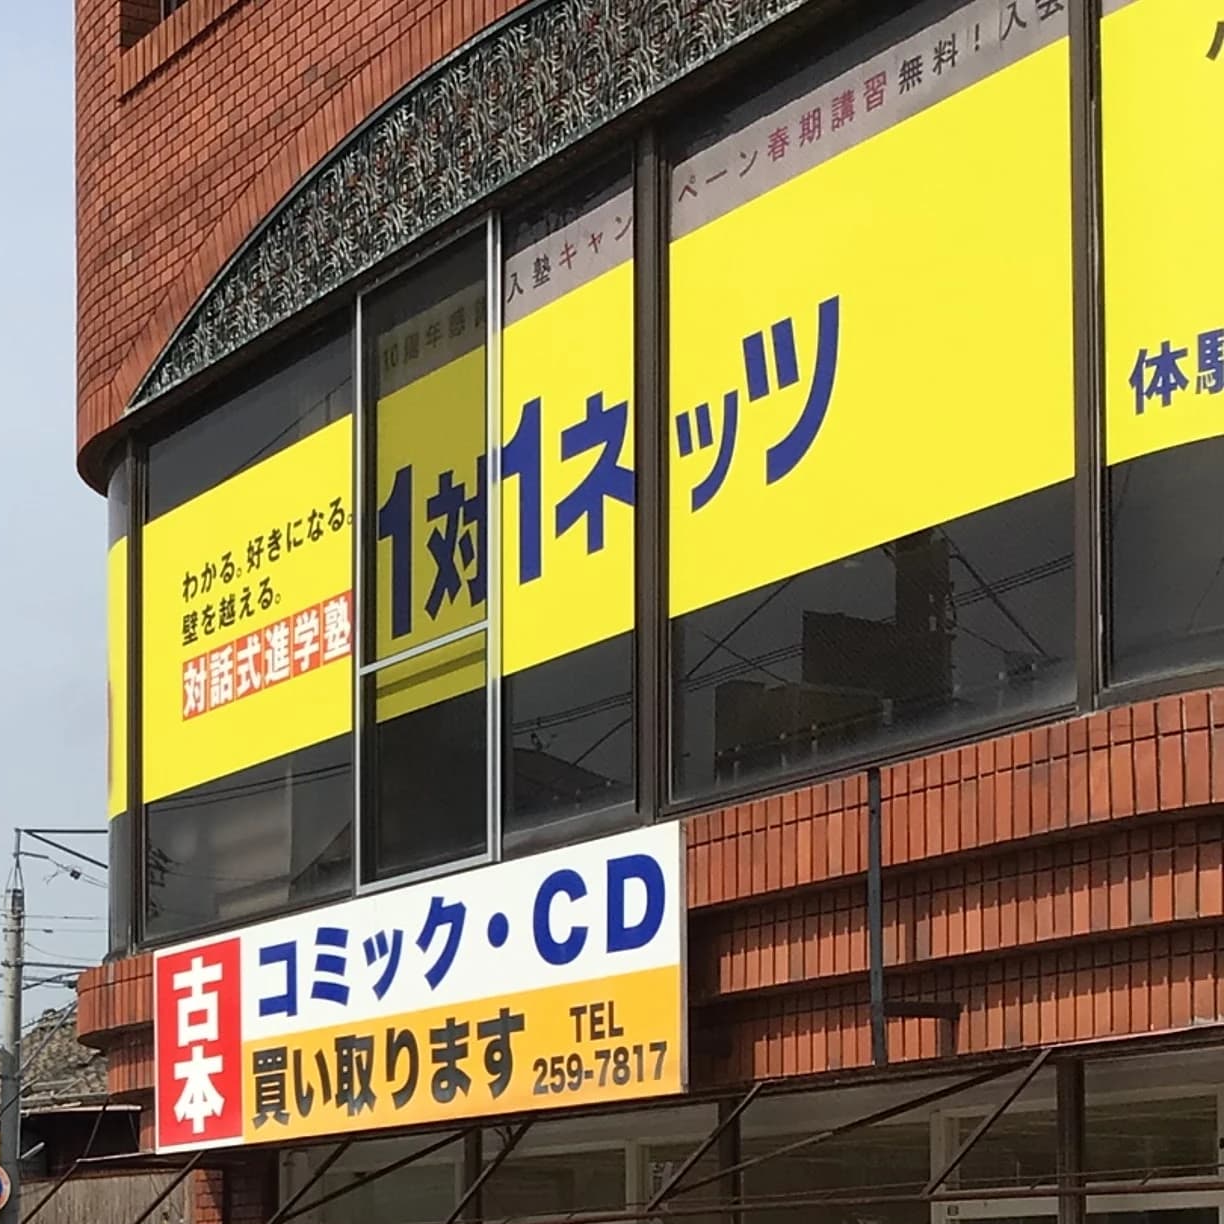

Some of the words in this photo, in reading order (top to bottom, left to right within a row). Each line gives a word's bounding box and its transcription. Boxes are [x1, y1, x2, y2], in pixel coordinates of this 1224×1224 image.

[183, 595, 352, 717] 対話式進学塾
[174, 956, 225, 1133] 古本
[252, 1008, 525, 1129] 買い取ります
[533, 1040, 668, 1095] 259-7817
[569, 1000, 624, 1043] TEL
